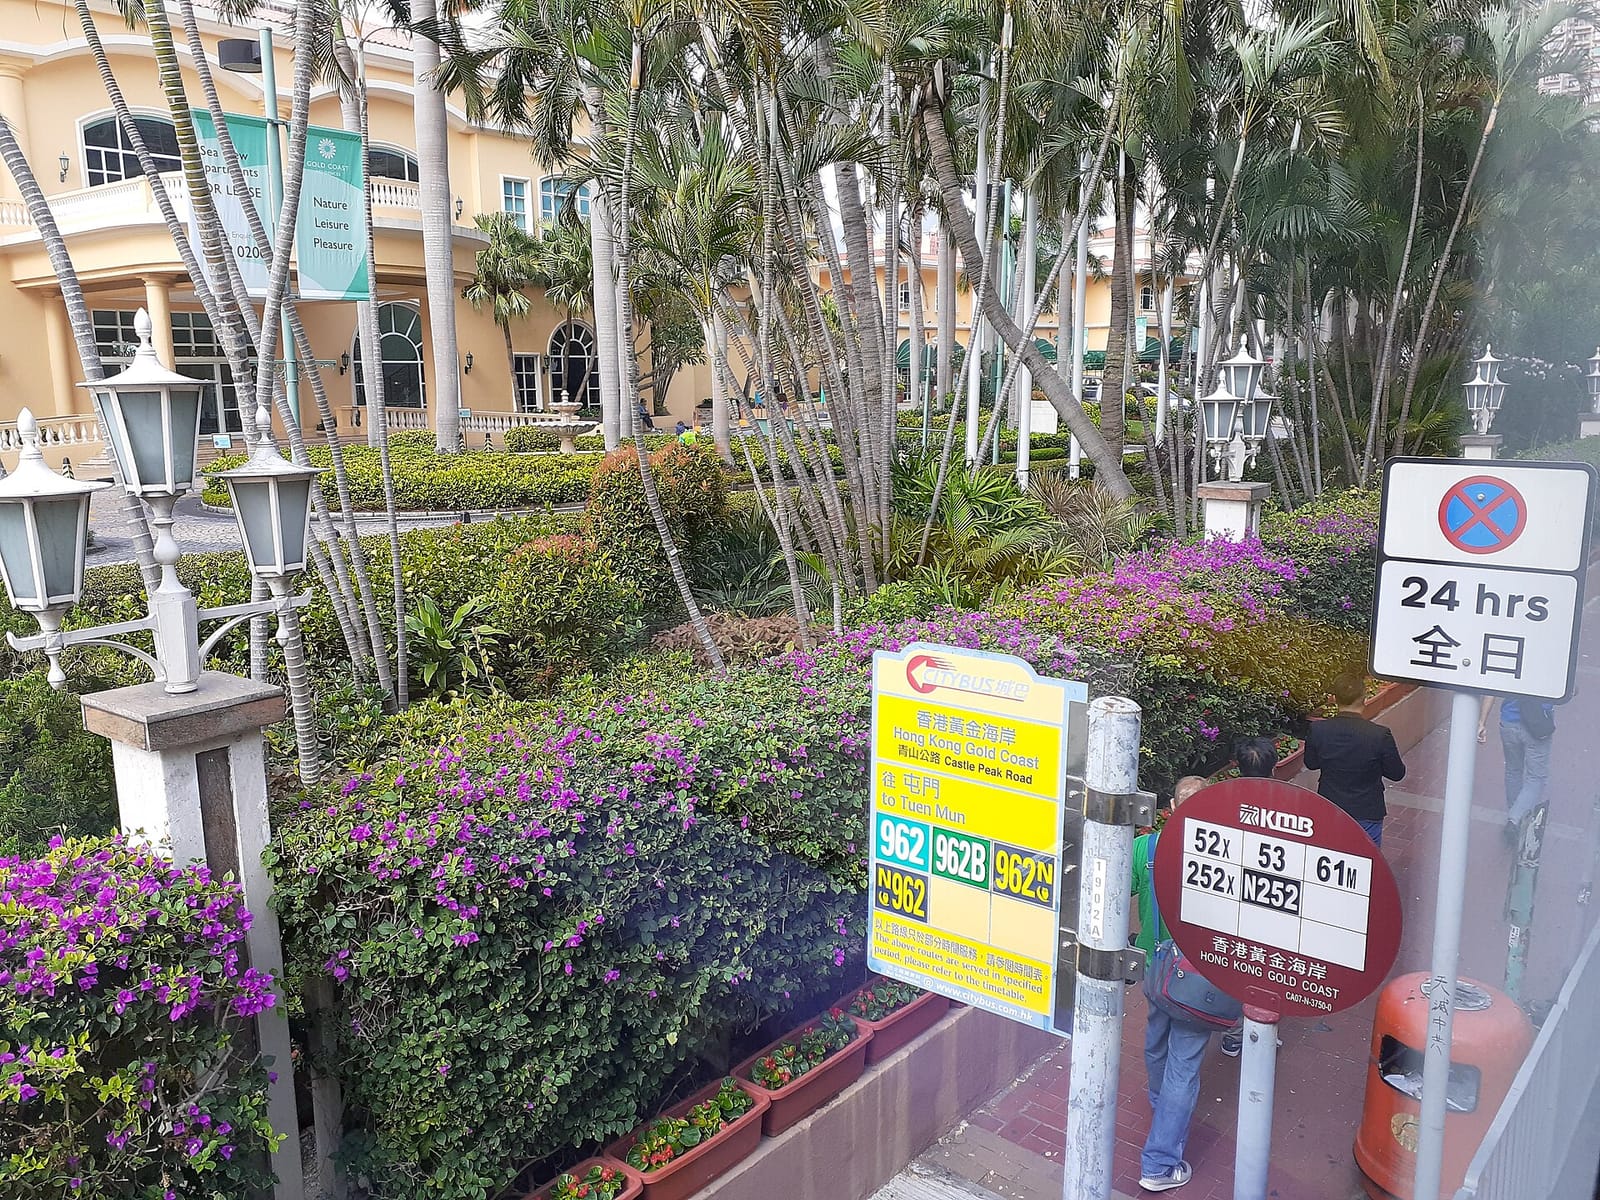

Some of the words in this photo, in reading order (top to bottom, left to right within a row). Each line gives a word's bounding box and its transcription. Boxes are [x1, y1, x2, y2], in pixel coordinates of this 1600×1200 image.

[200, 145, 219, 158] Sea
[306, 160, 326, 169] GOLD
[205, 165, 259, 178] partnts
[226, 185, 263, 199] LESE
[313, 196, 348, 211] Nature
[314, 217, 350, 231] Leisure
[237, 245, 266, 259] 020
[313, 237, 353, 251] Pleasure
[1400, 575, 1461, 612] 24
[1475, 583, 1550, 622] hrs
[1409, 624, 1526, 680] 全日
[923, 667, 995, 694] CITYBUS
[893, 726, 925, 748] Hong
[929, 733, 962, 756] Kong
[965, 742, 996, 761] Gold
[1000, 749, 1040, 770] Coast
[897, 744, 941, 766] 青山公路
[944, 755, 976, 773] Castle
[978, 764, 1003, 779] Peak
[1005, 769, 1033, 785] Road
[882, 771, 897, 789] 往
[903, 773, 940, 800] 屯門
[881, 792, 896, 807] to
[900, 795, 932, 817] Tuen
[935, 803, 966, 825] Mun
[880, 818, 926, 866] 962
[935, 833, 987, 883] 962B
[1193, 827, 1231, 860] 52X
[1257, 841, 1286, 872] 53
[995, 849, 1053, 899] 962N
[1186, 860, 1235, 896] 252X
[1316, 855, 1357, 890] 61M
[878, 866, 926, 918] N962
[1243, 873, 1299, 912] N252
[874, 931, 890, 945] The
[891, 937, 916, 952] above
[917, 946, 944, 962] routes
[945, 956, 960, 967] are
[961, 961, 990, 977] served
[991, 968, 1001, 981] in
[1003, 975, 1043, 995] specified
[874, 945, 902, 963] period,
[904, 954, 930, 970] please
[931, 965, 952, 979] refer
[954, 971, 964, 982] to
[965, 974, 981, 988] the
[982, 980, 1027, 1003] timetable.
[1199, 950, 1230, 968] HONG
[1233, 959, 1263, 978] KONG
[1267, 970, 1297, 988] GOLD
[1302, 980, 1340, 1000] COAST
[1212, 935, 1327, 981] 香港黃金海岸
[936, 983, 1034, 1022] www.citybus.com.hk
